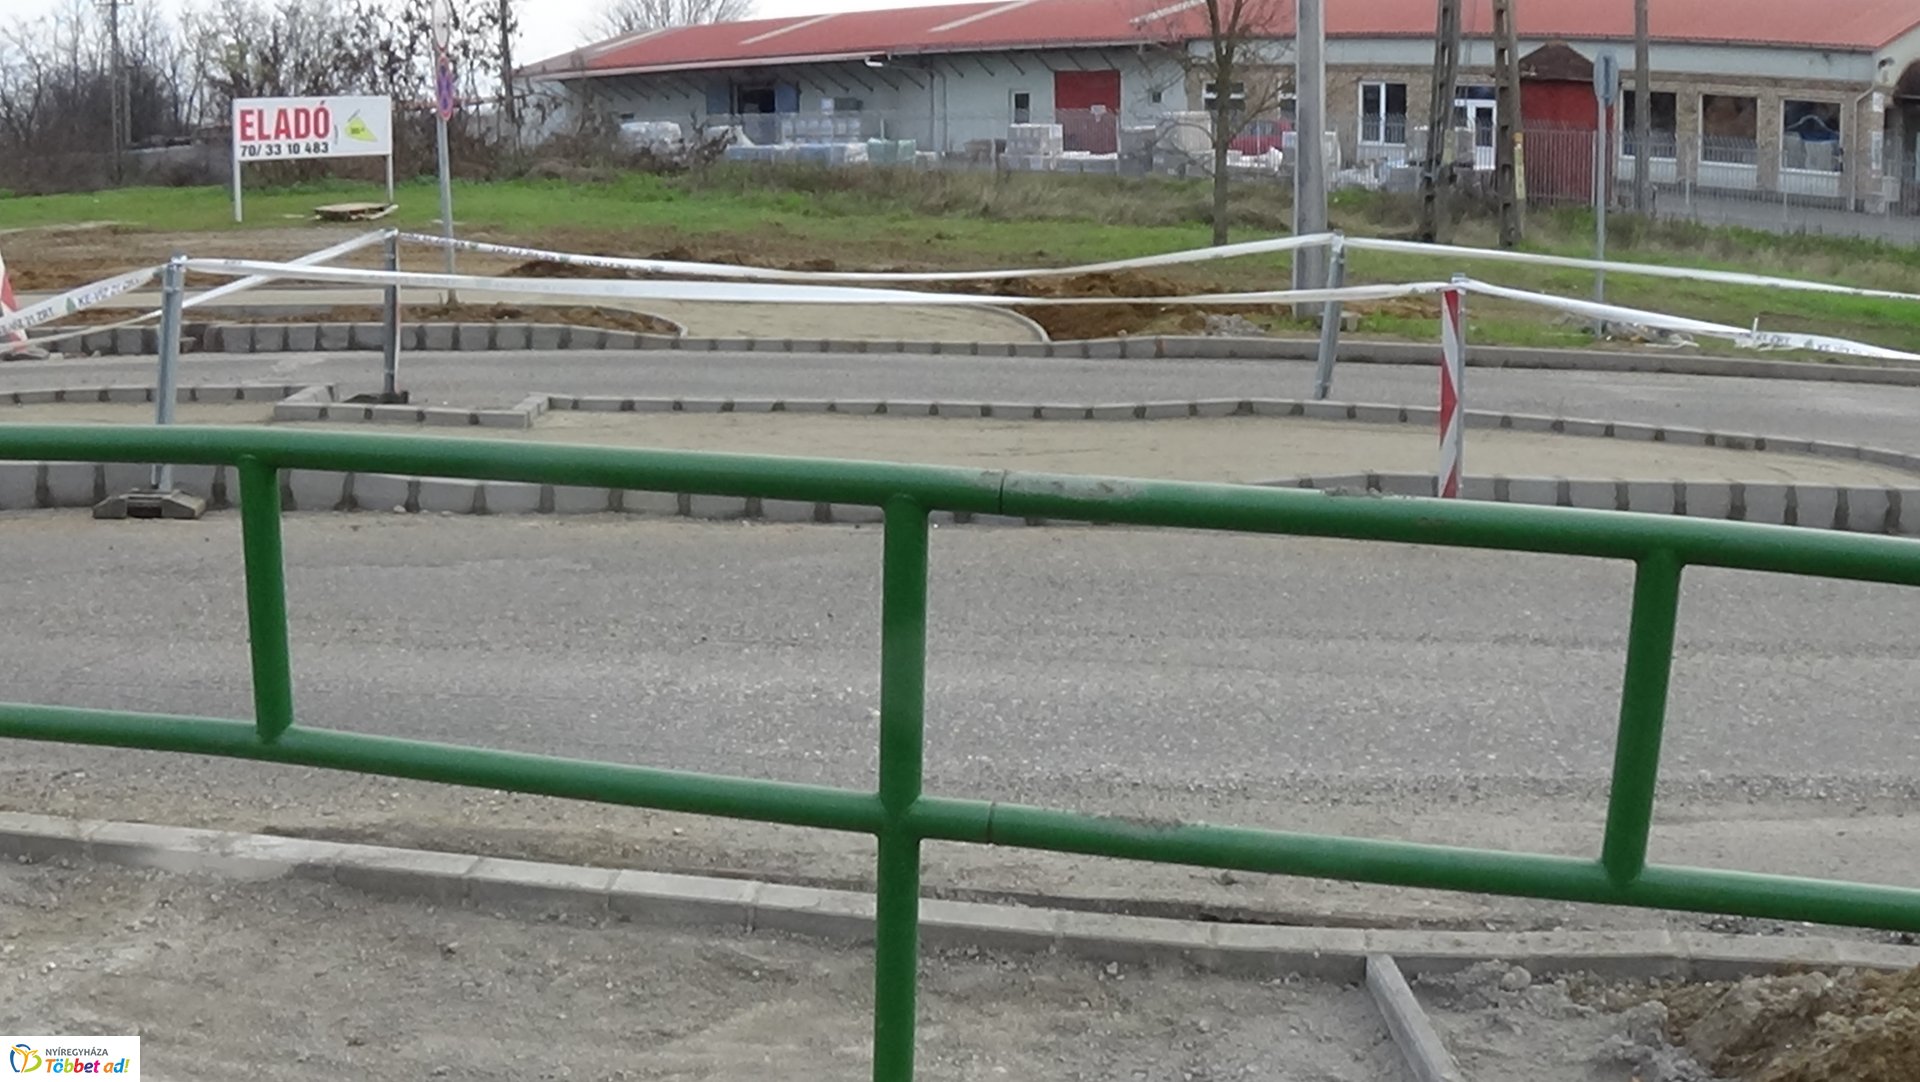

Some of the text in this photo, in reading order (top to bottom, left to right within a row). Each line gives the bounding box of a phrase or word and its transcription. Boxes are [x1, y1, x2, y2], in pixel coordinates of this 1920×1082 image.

[239, 100, 330, 142] ELADÓ
[265, 143, 282, 156] 33
[287, 143, 301, 155] 10
[304, 142, 329, 154] 483
